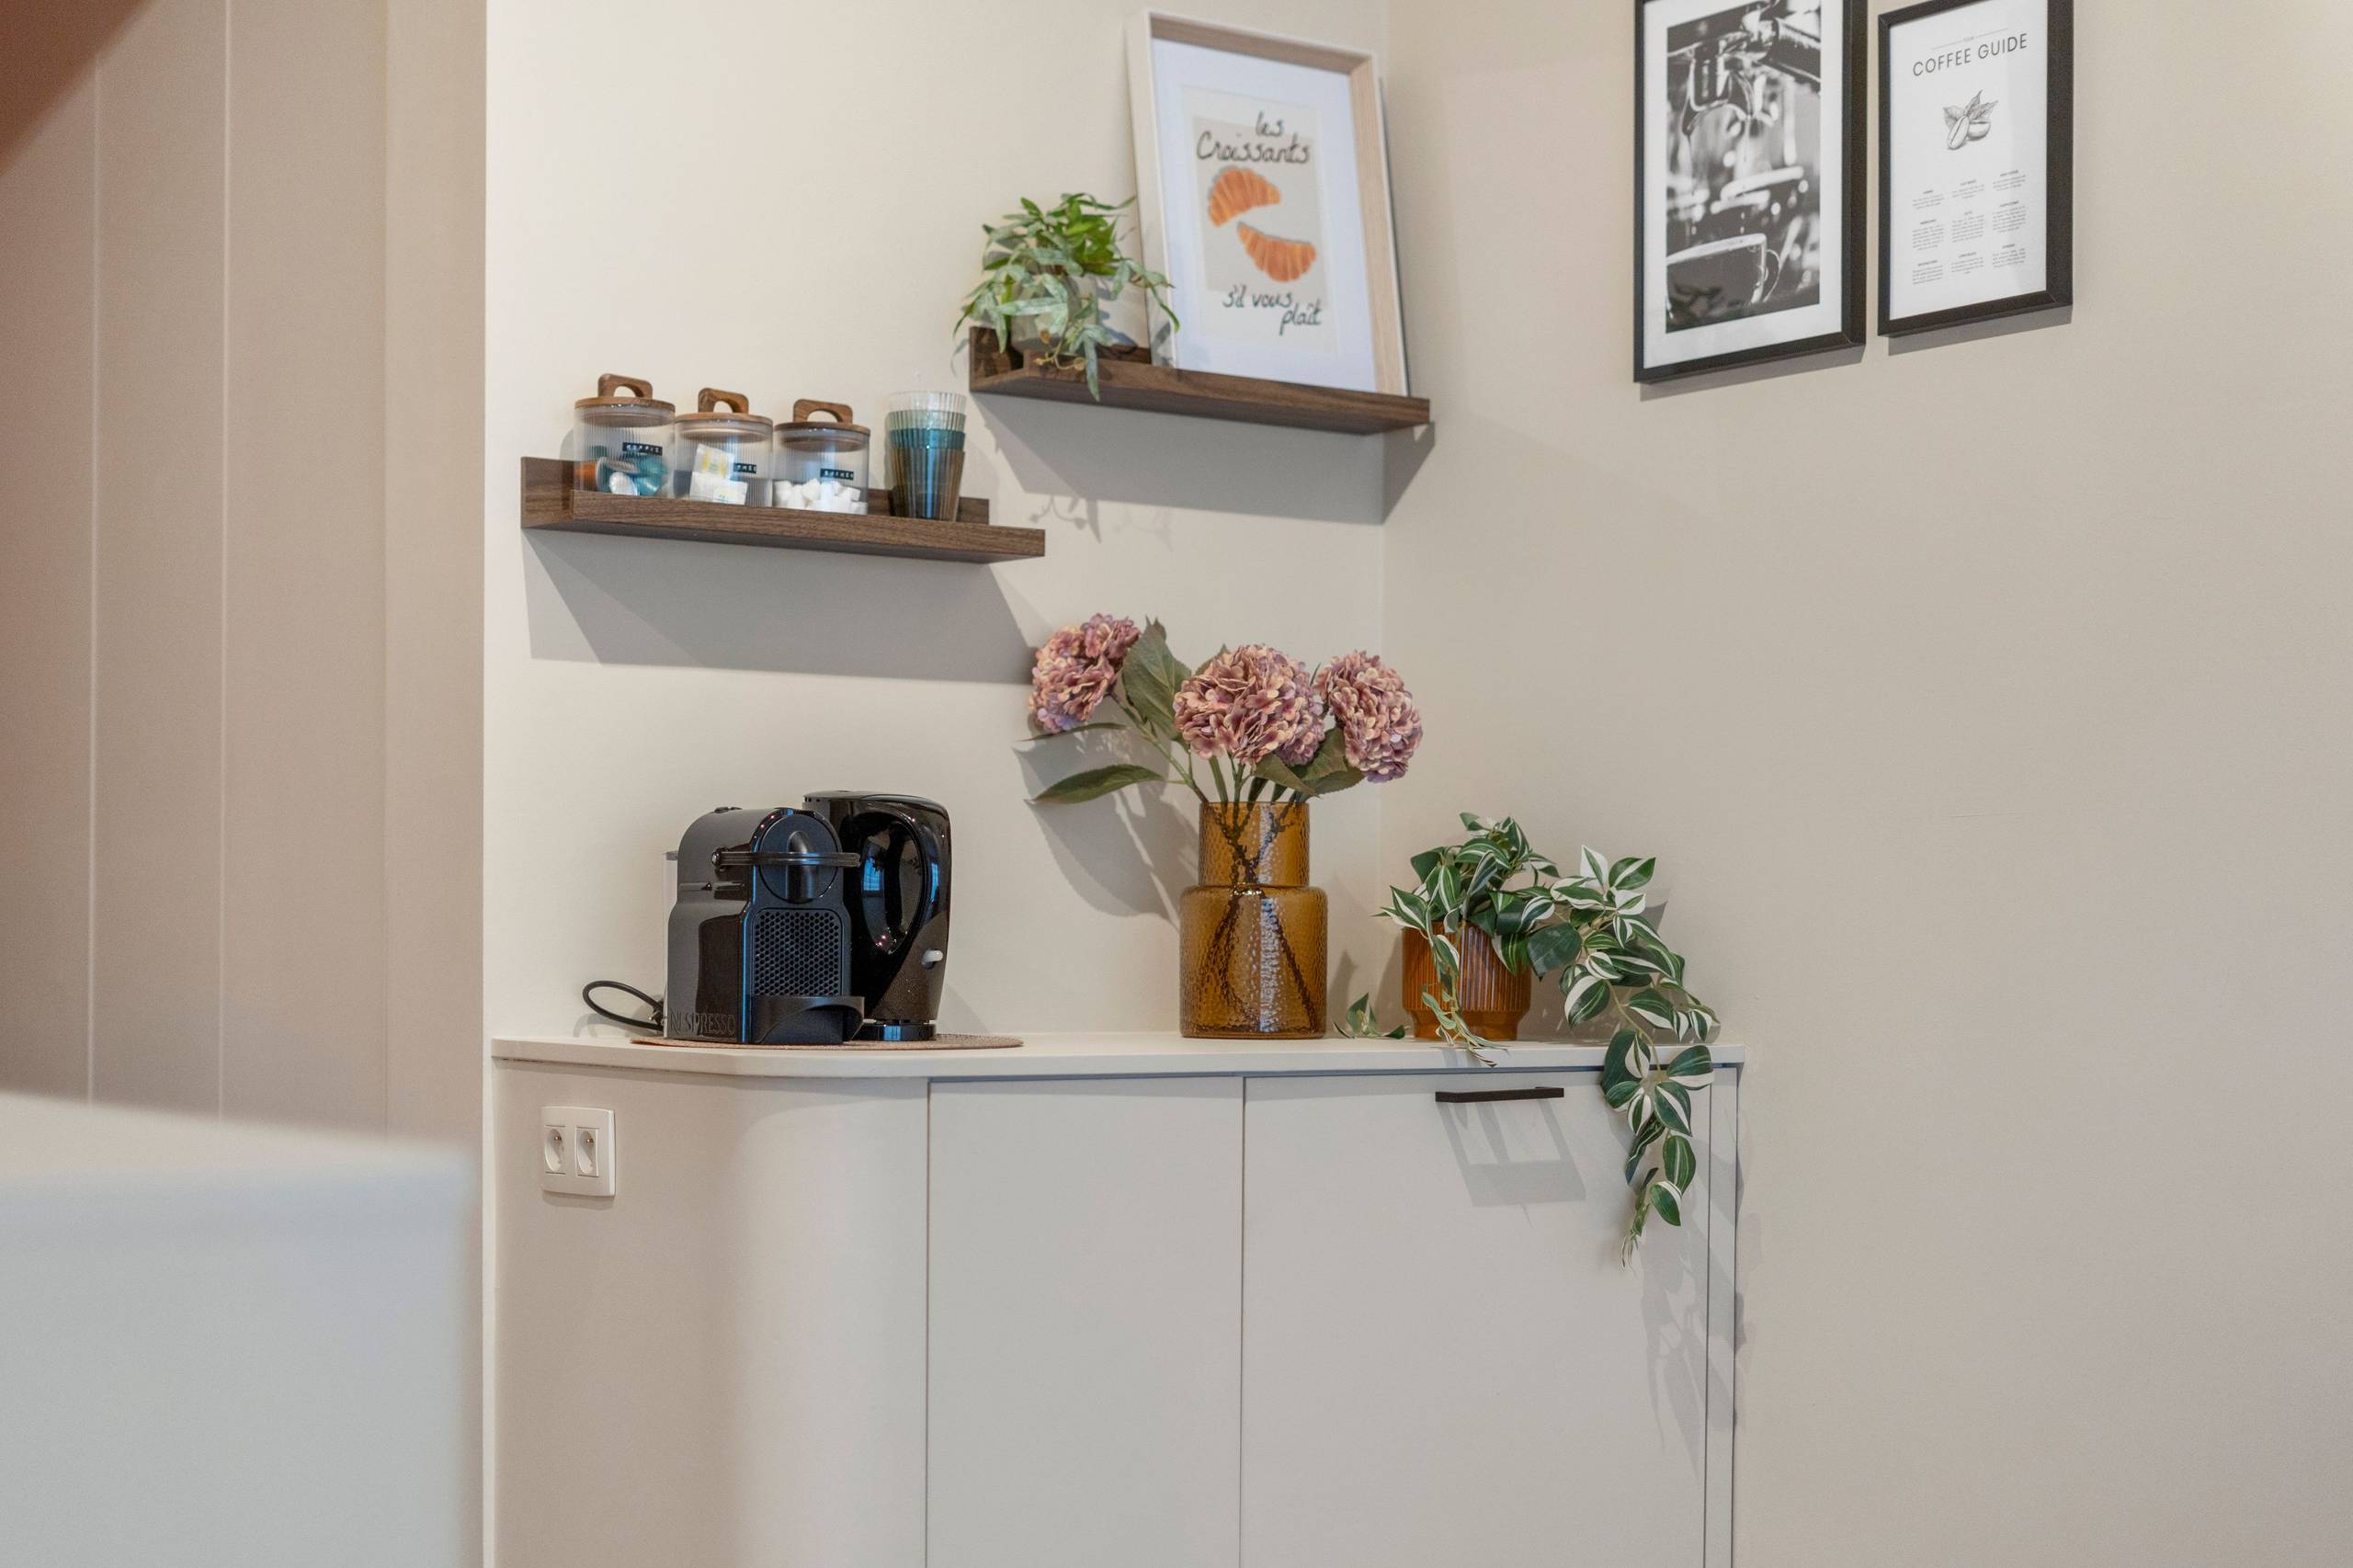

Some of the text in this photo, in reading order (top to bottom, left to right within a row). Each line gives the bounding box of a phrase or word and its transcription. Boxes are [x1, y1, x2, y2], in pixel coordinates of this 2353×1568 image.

[1913, 33, 2028, 76] COFFEE GUIDE
[1255, 110, 1284, 137] les
[1196, 130, 1310, 164] Croissants
[1252, 292, 1293, 308] vous
